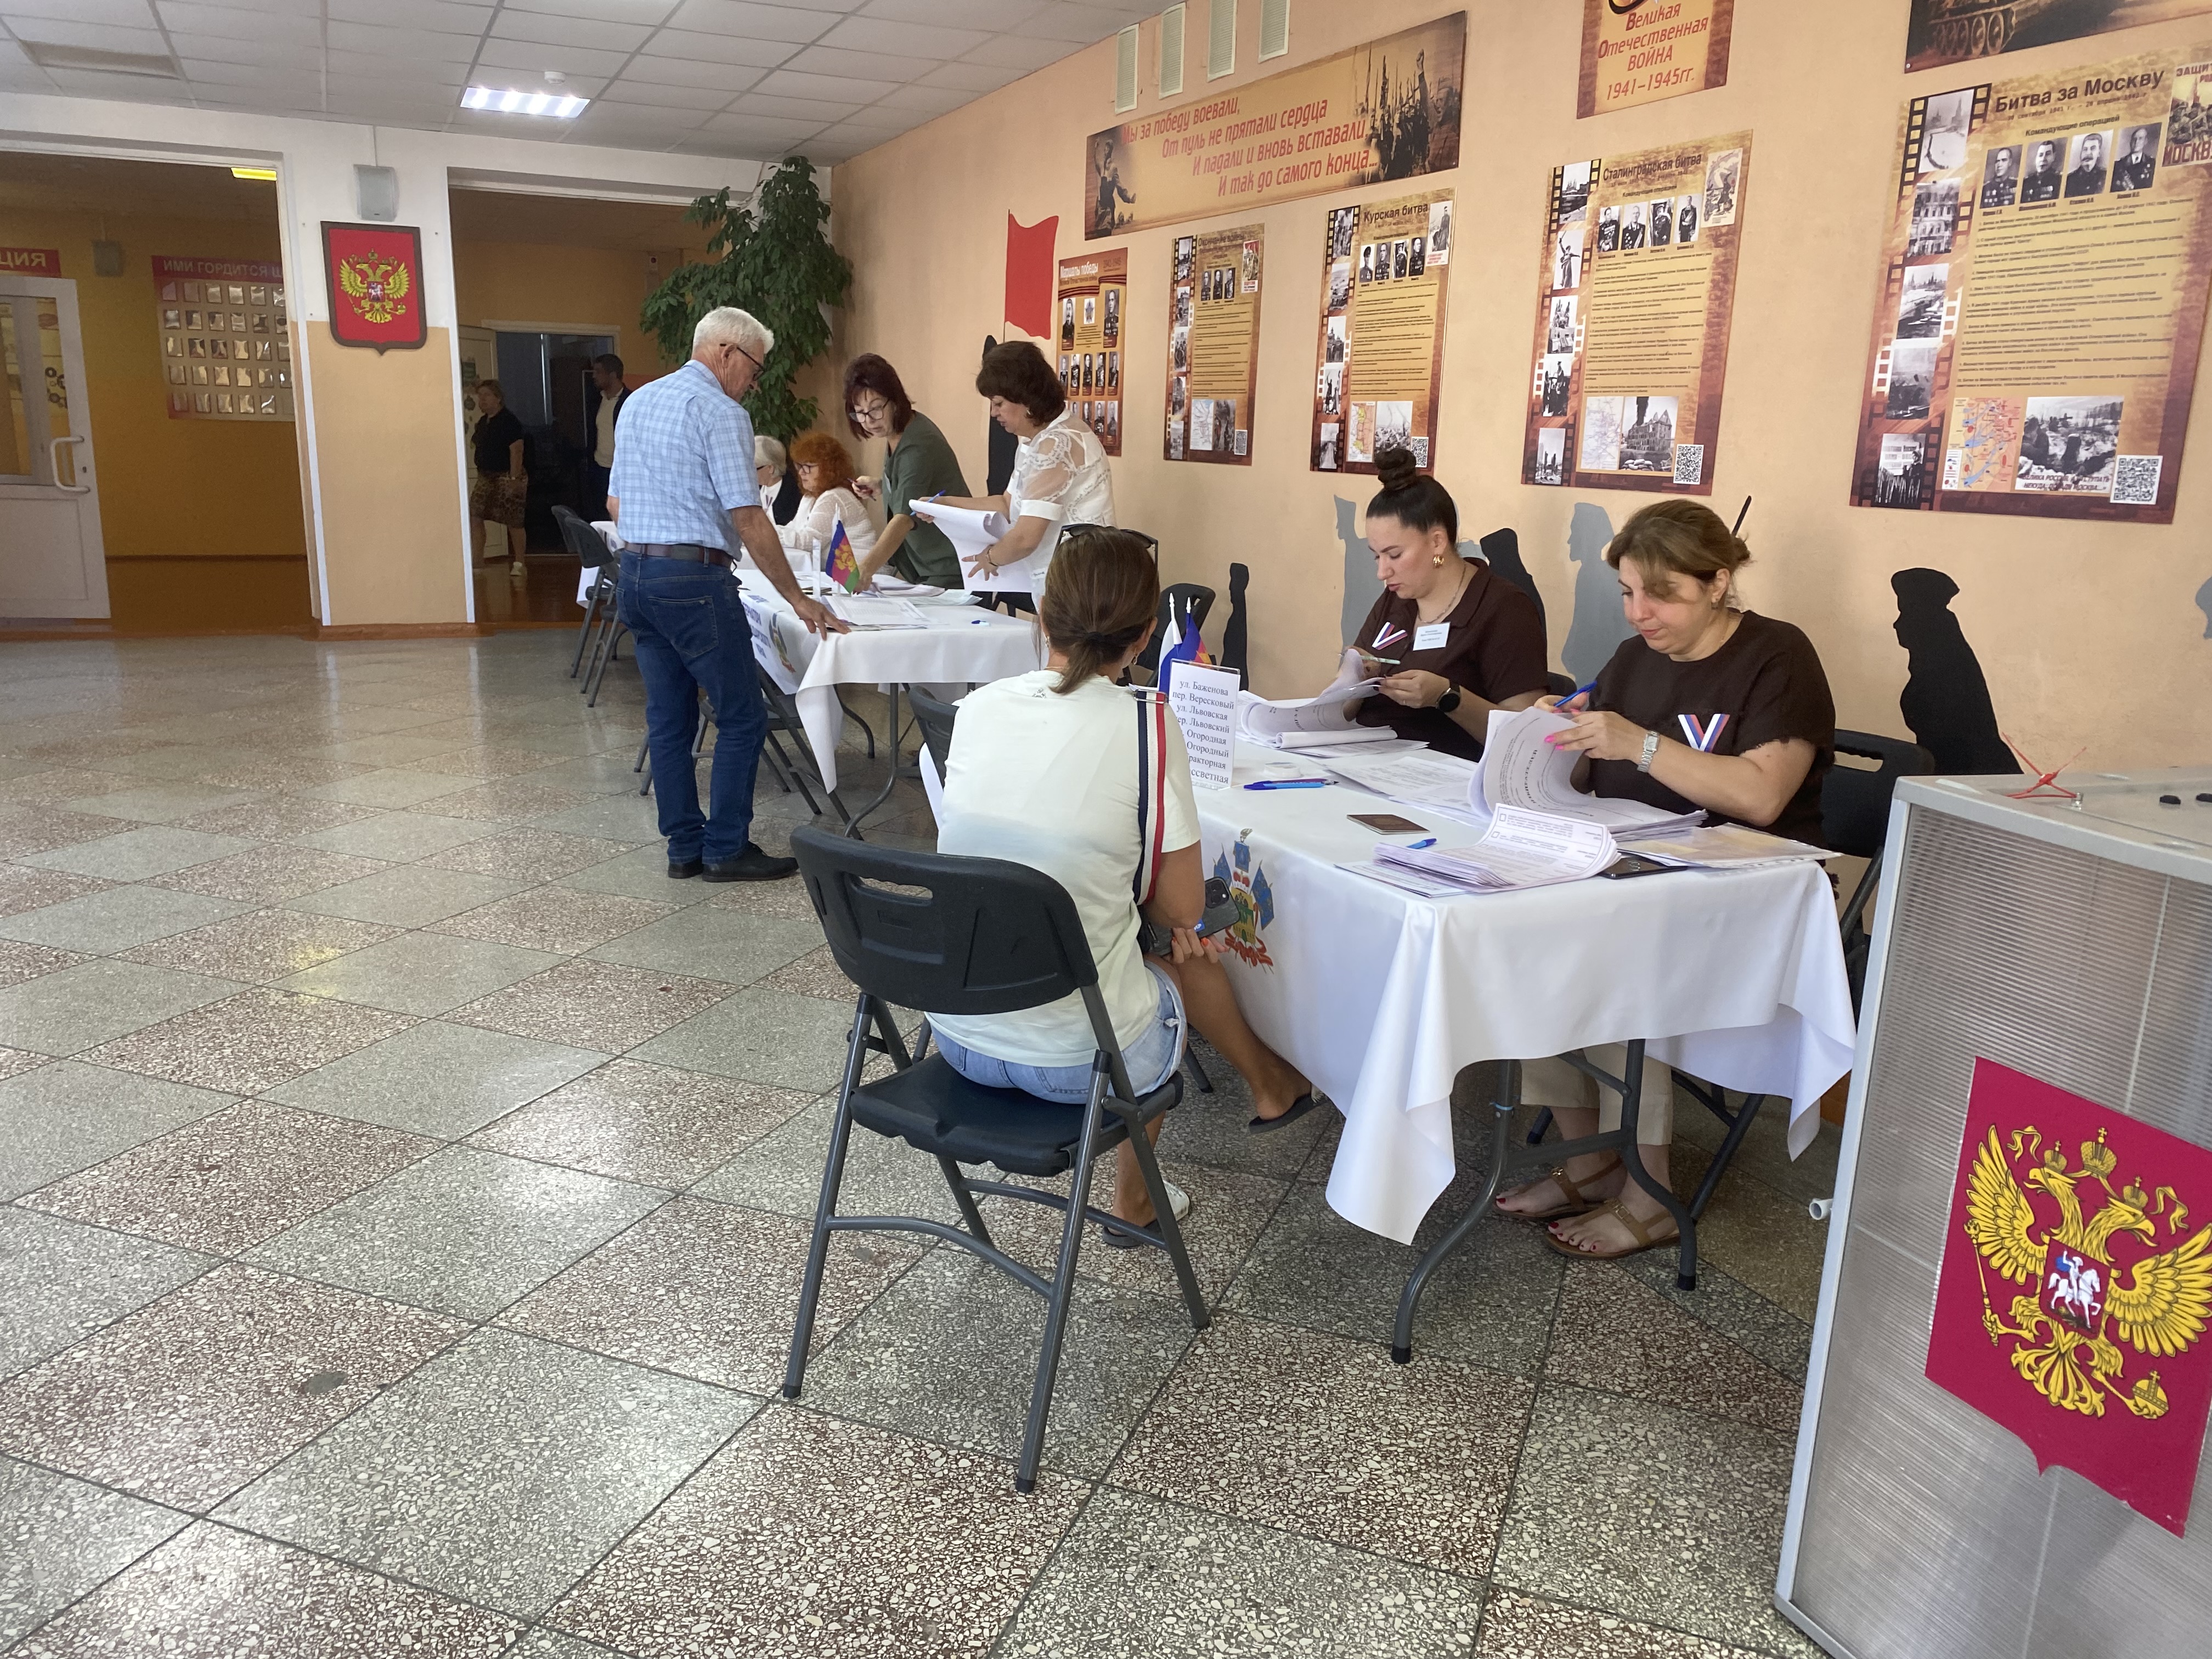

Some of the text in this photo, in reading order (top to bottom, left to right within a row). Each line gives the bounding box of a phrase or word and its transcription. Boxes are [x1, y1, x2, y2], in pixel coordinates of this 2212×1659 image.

[1626, 3, 1681, 31] Великая
[1598, 17, 1709, 59] Отечественная
[1627, 45, 1673, 71] ВОЙНА
[1995, 70, 2165, 112] Битва за Москву
[1122, 97, 1240, 145] Мы за победу воевали,
[1162, 99, 1328, 159] От пуль не прятали сердца
[2025, 114, 2120, 136] Командующие операцией
[1193, 155, 1201, 176] И
[1204, 149, 1244, 175] падали
[1246, 146, 1254, 164] и
[1257, 138, 1293, 161] вновь
[2162, 140, 2212, 167] МОСКВ
[1218, 175, 1227, 197] И
[1230, 170, 1254, 194] так
[1257, 170, 1273, 193] до
[1276, 160, 1322, 185] самого
[1603, 154, 1702, 181] Сталинградская битва
[1364, 208, 1400, 224] Курская
[1402, 204, 1428, 216] битва
[163, 260, 193, 272] ИМИ
[198, 262, 268, 277] ГОРДИТСЯ
[1193, 681, 1228, 696] Баженова
[1172, 691, 1234, 709] пер. Вересковый
[1189, 706, 1228, 720] Львовская
[1176, 716, 1229, 733] ер. Львовский
[1187, 729, 1226, 744] Огородная
[1187, 741, 1229, 758] Огородный
[1188, 753, 1226, 769] ракторная
[1190, 769, 1229, 783] ссветная
